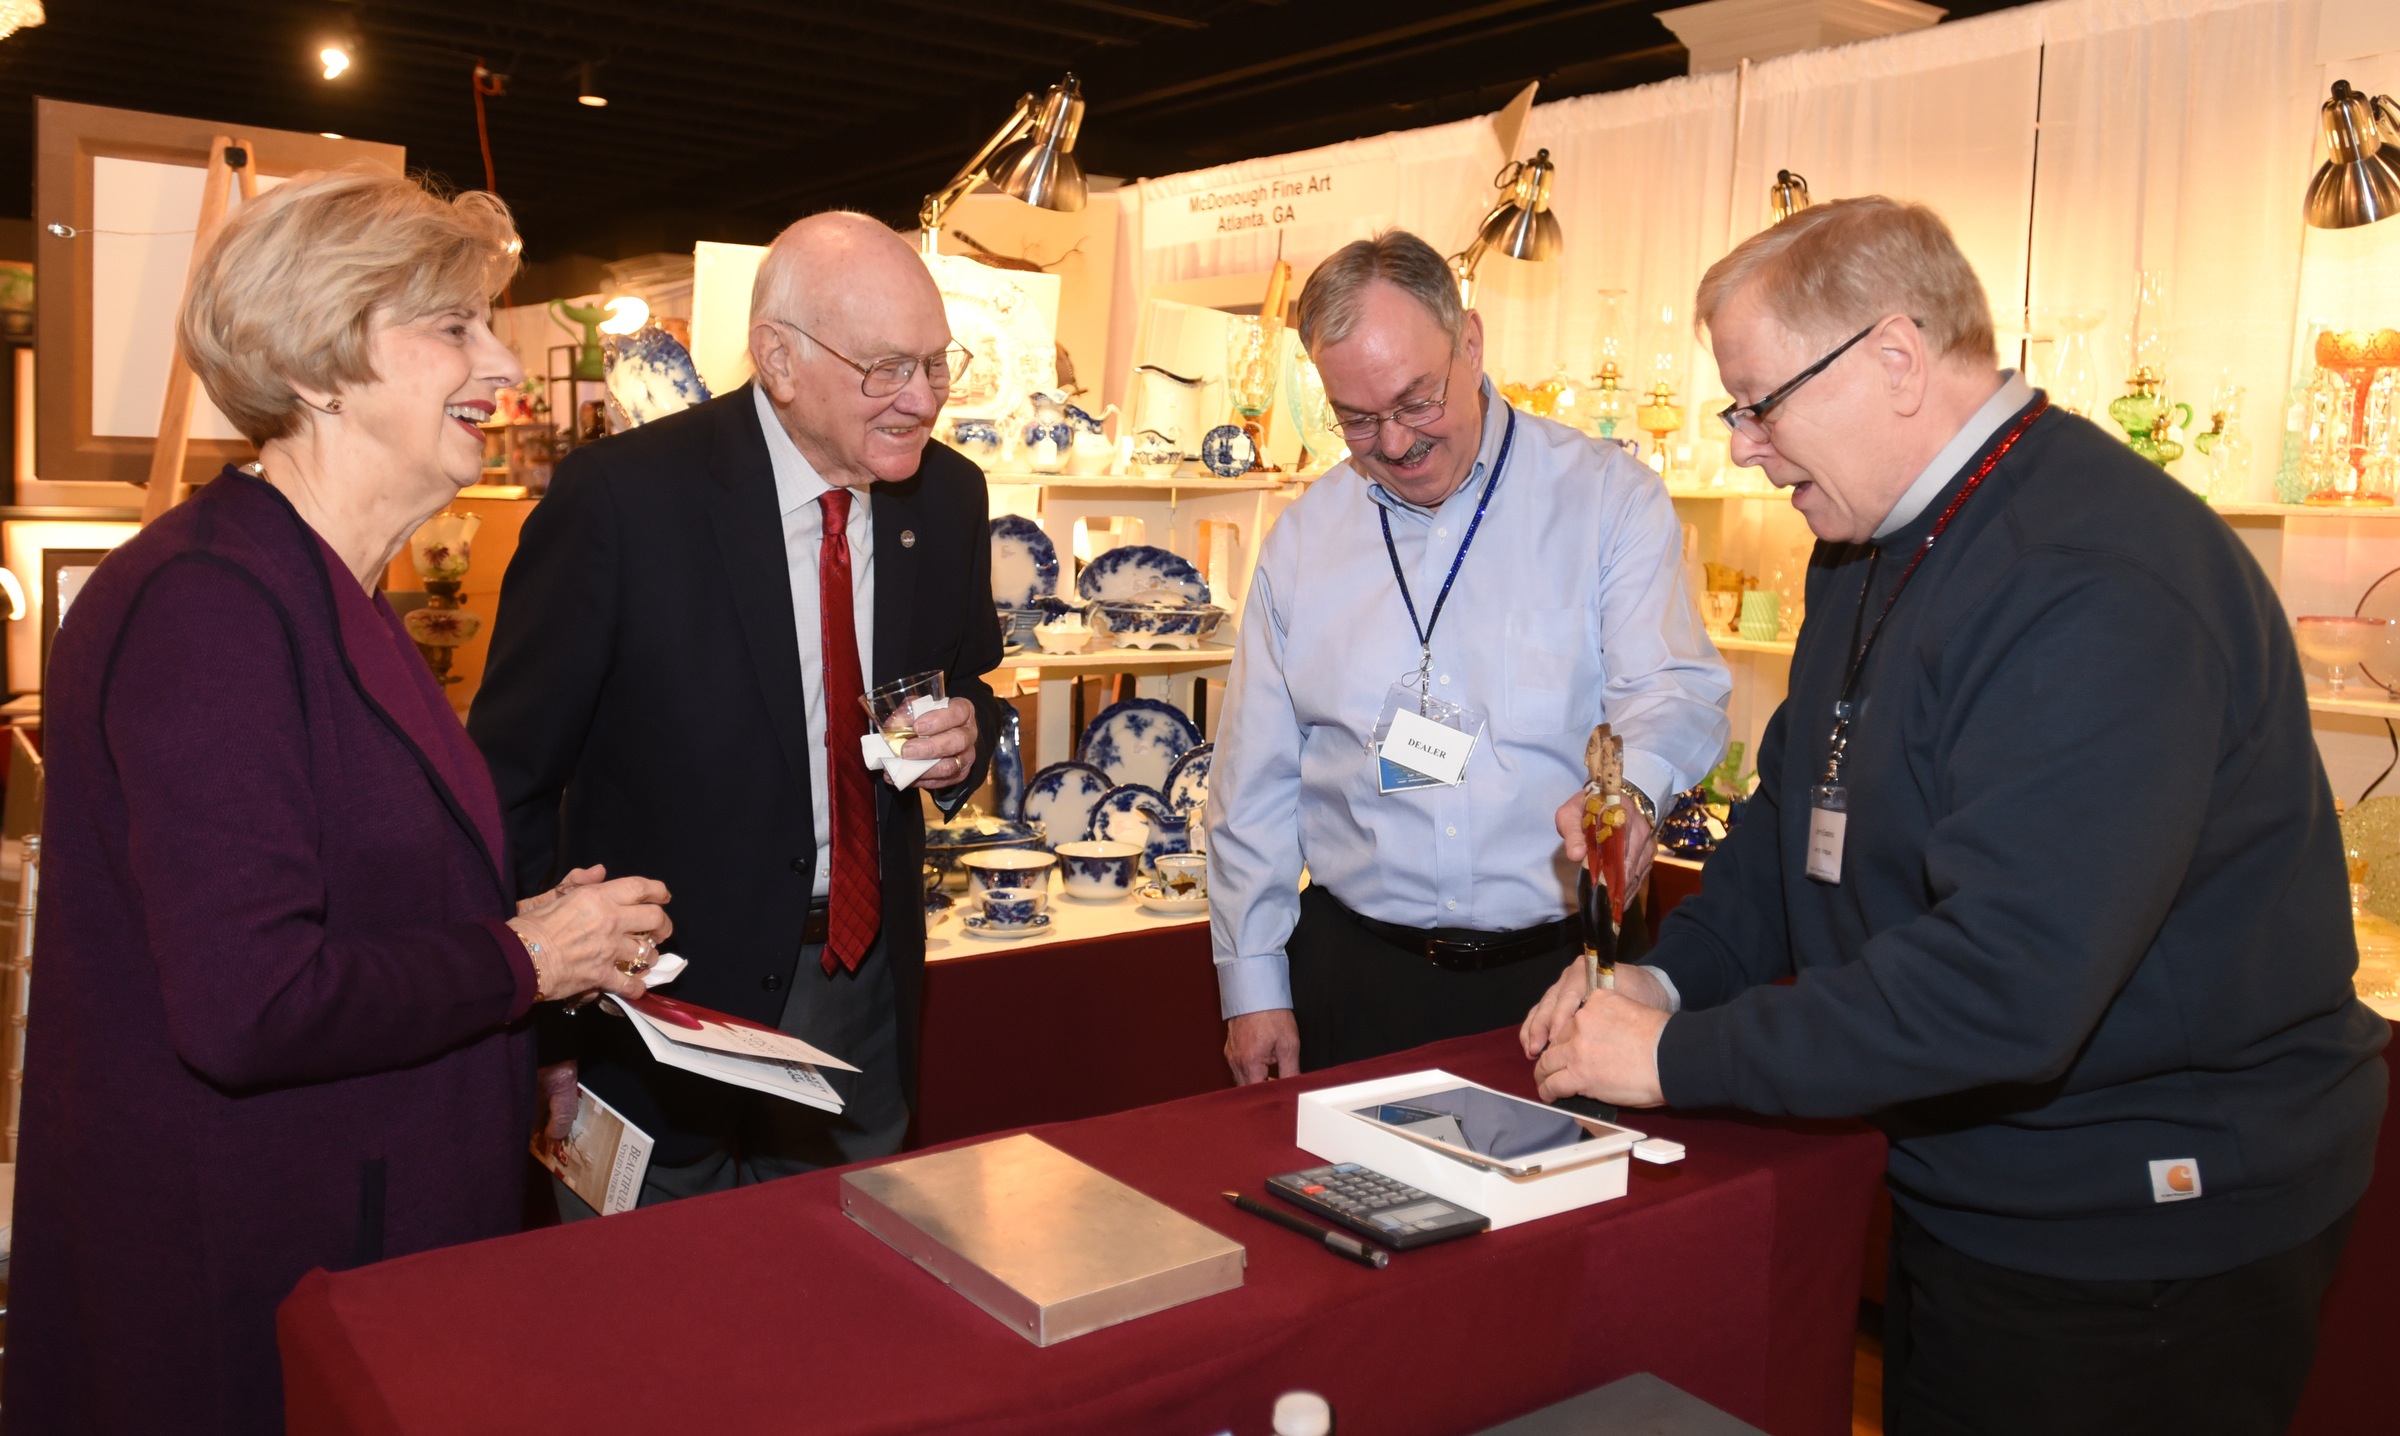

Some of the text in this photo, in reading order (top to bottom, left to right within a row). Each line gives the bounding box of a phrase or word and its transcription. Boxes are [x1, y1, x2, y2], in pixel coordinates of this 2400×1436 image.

[1189, 173, 1331, 213] McDonough Fine Art
[1272, 204, 1295, 224] GA
[1407, 738, 1447, 759] DEALER
